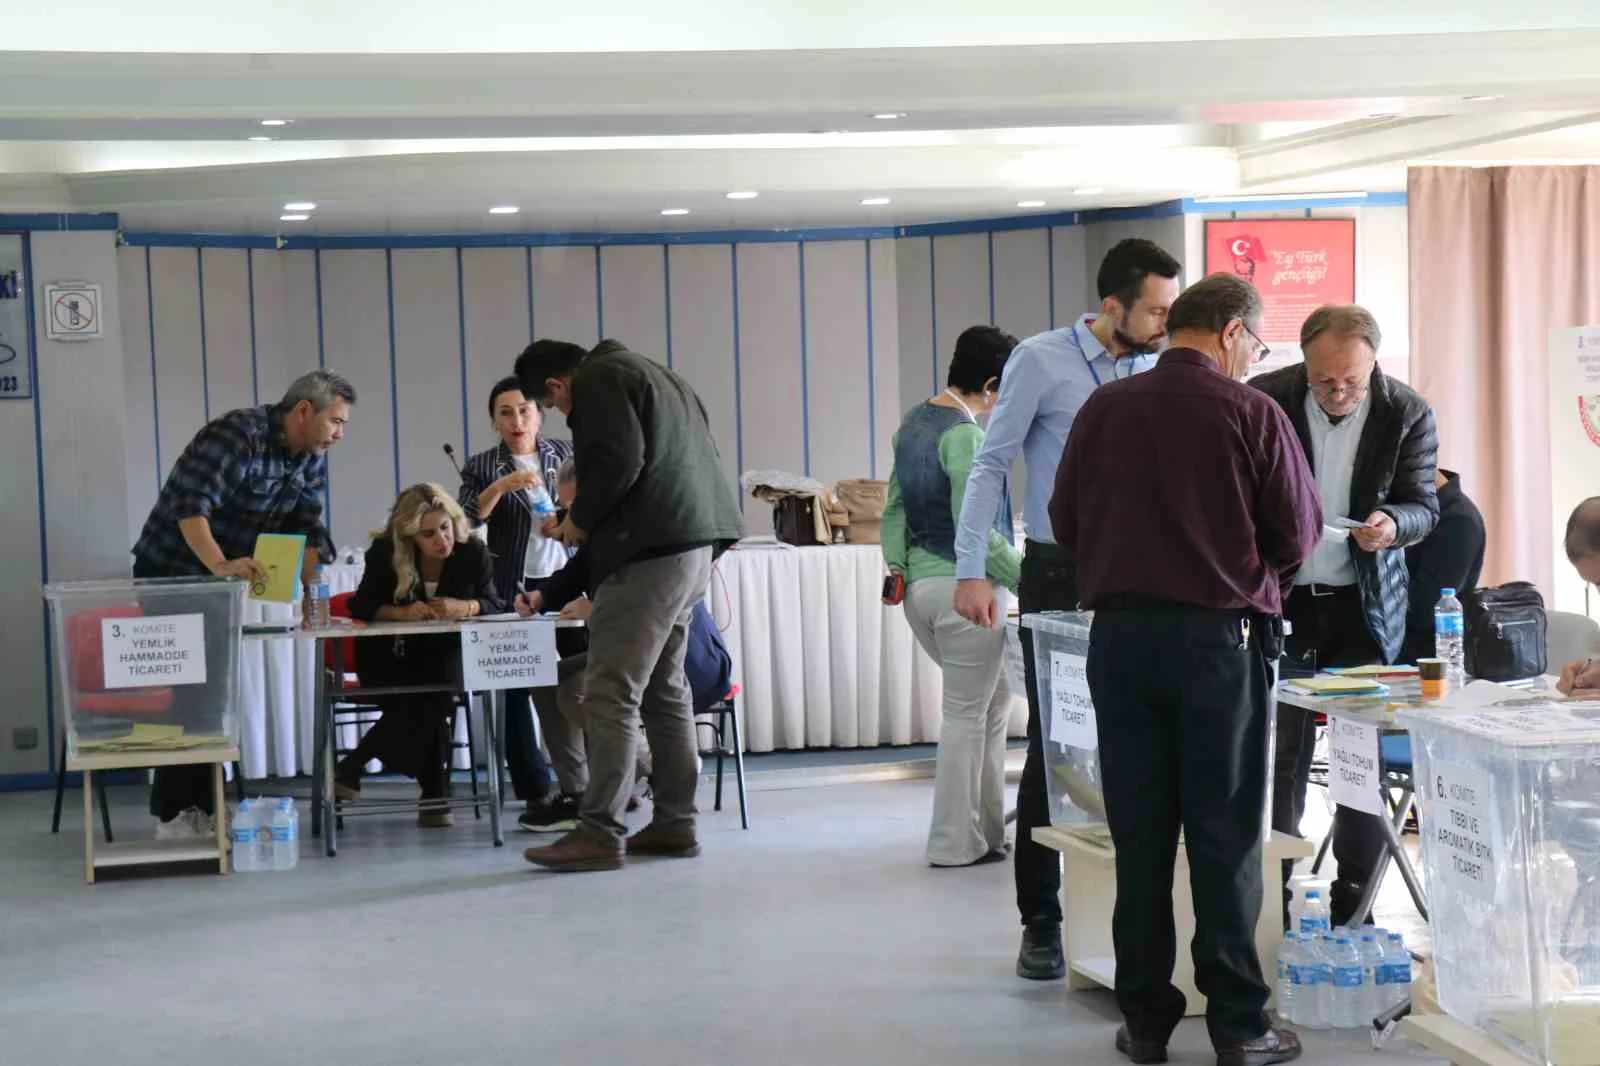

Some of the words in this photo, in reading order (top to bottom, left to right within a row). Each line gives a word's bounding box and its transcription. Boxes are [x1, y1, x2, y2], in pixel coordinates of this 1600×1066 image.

[0, 376, 18, 392] 23
[112, 624, 126, 638] 3.
[470, 630, 483, 643] 3.
[120, 650, 191, 662] HAMMADDE
[478, 654, 542, 667] HAMMADDE
[1437, 775, 1448, 799] 6.
